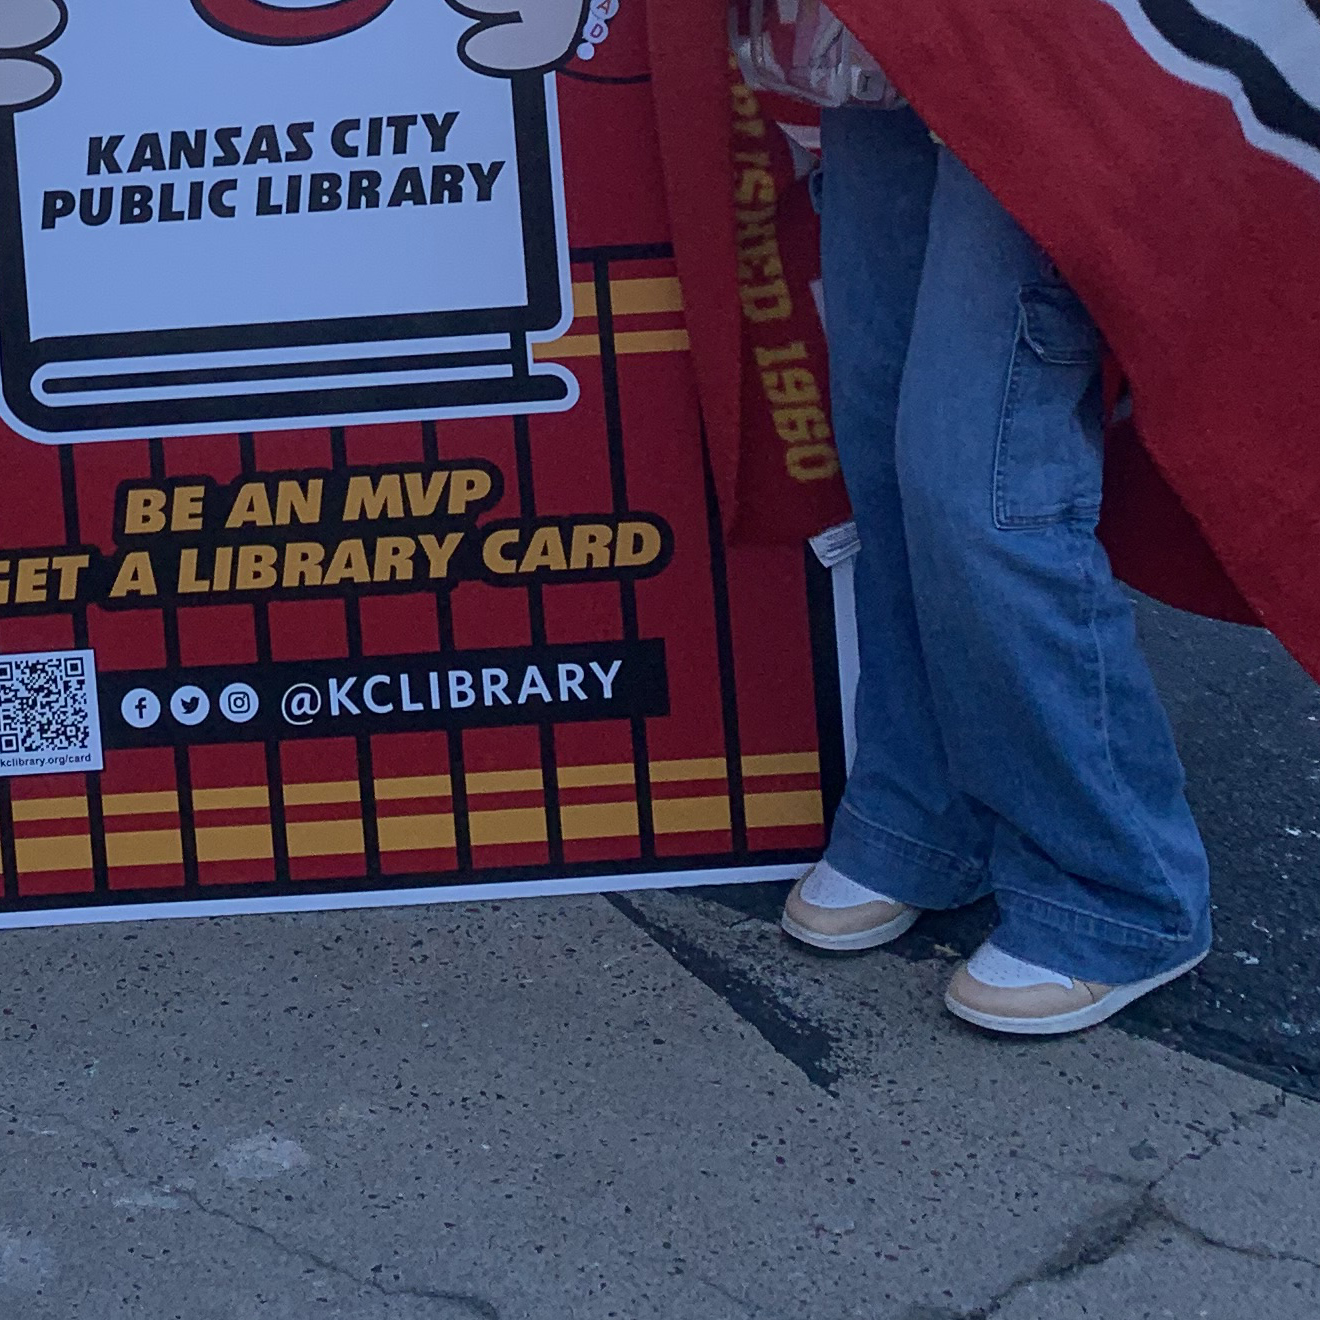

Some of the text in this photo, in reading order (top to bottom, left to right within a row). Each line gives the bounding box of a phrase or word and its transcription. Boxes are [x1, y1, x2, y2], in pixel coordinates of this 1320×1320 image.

[86, 111, 460, 175] KANSAS CITY
[41, 160, 506, 230] PUBLIC LIBRARY
[754, 340, 840, 486] 1960
[123, 469, 492, 536] BE AN MVP
[108, 551, 159, 598] A
[176, 531, 465, 594] LIBRARY
[481, 521, 662, 575] CARD
[281, 658, 624, 726] @KCLIBRARY
[0, 753, 92, 768] kclibrary.org/card
